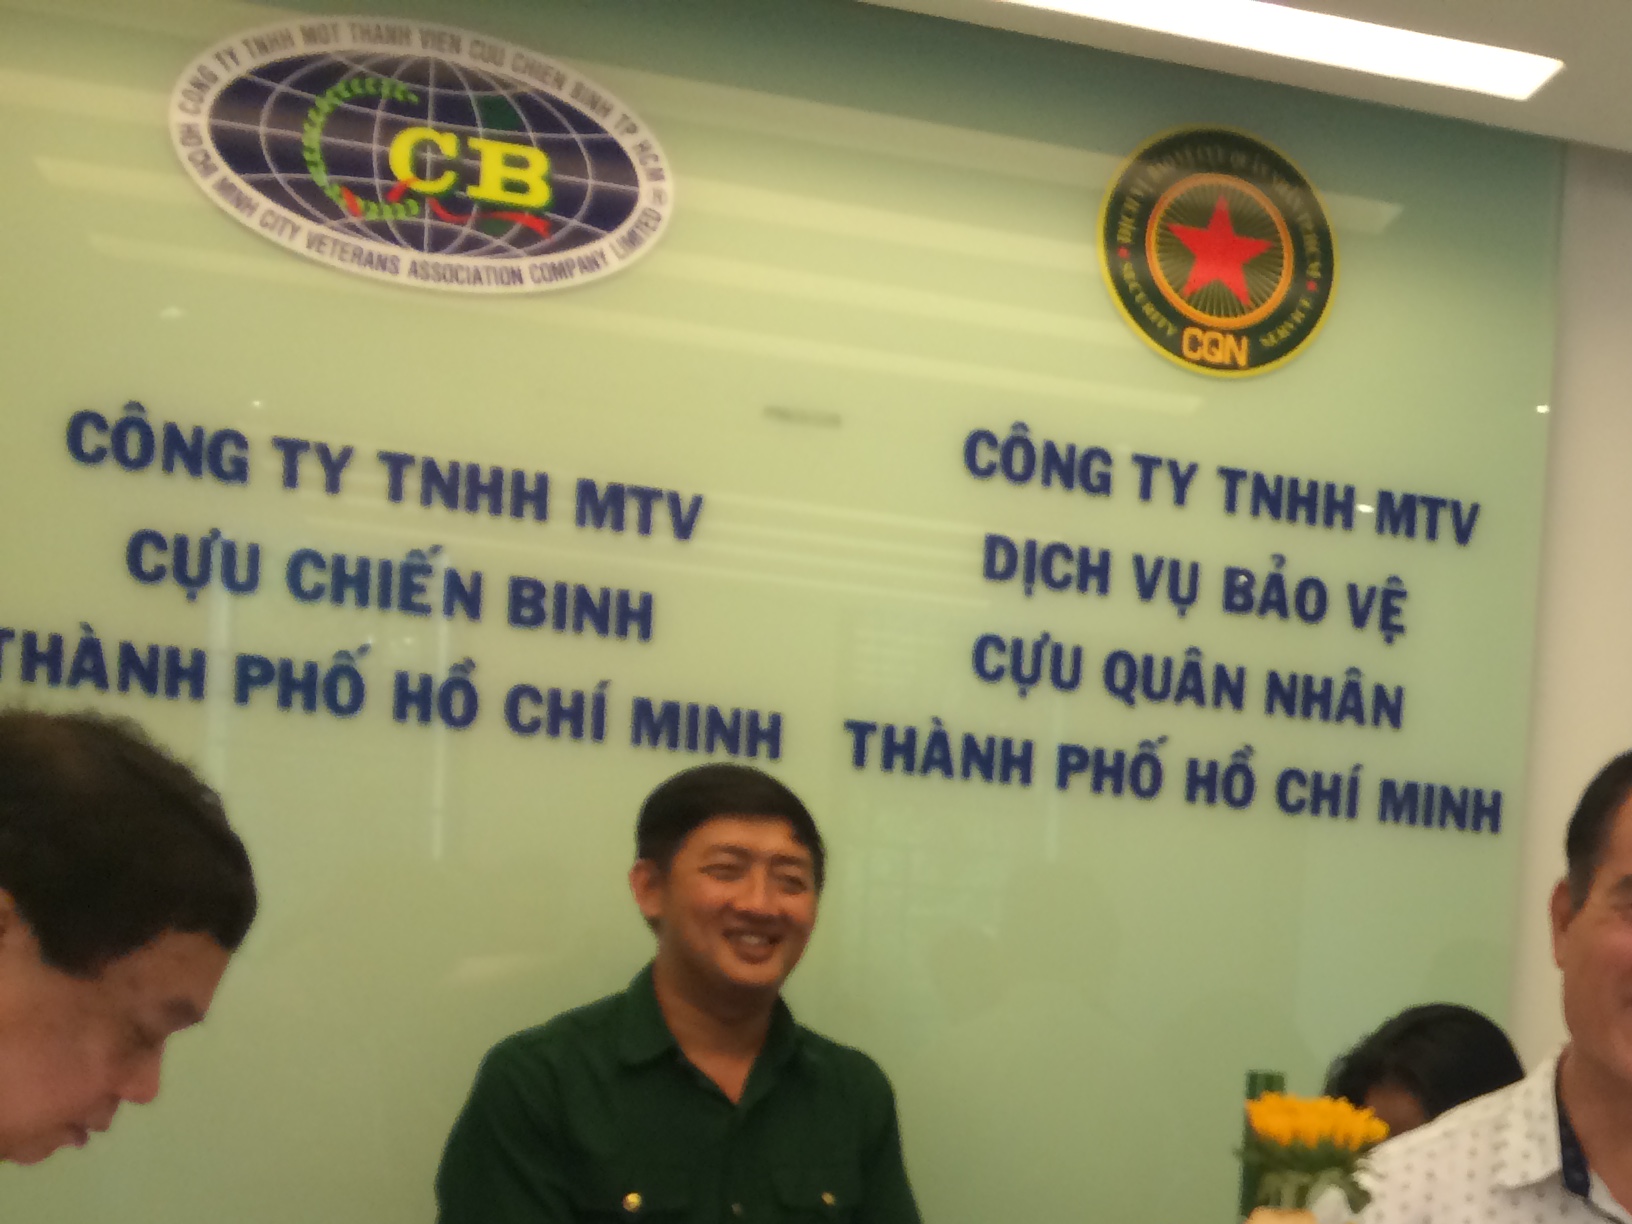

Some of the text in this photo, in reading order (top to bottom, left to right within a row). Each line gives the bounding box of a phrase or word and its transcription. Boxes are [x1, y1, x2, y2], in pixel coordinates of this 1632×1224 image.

[388, 126, 551, 210] CB
[258, 208, 302, 243] CITY
[304, 230, 401, 277] VETERANS
[406, 258, 525, 287] ASSOCIATION
[527, 249, 610, 286] COMPANY
[607, 205, 664, 262] LIMITED
[1181, 326, 1249, 368] CQN
[67, 402, 703, 541] CÔNG TY TNHH MTV
[964, 422, 1480, 546] CÔNG TY TNHH MTV
[127, 528, 654, 641] CỰU CHIẾN BINH
[984, 534, 1408, 645] DỊCH VỤ BẢO VỆ
[235, 645, 371, 718] PHỐ
[393, 657, 479, 729] HỒ
[505, 681, 608, 742] CHÍ
[631, 697, 783, 761] MINH
[973, 630, 1405, 729] CỰU QUÂN NHÂN
[845, 717, 1503, 835] THÀNH PHỐ HỒ CHÍ MINH
